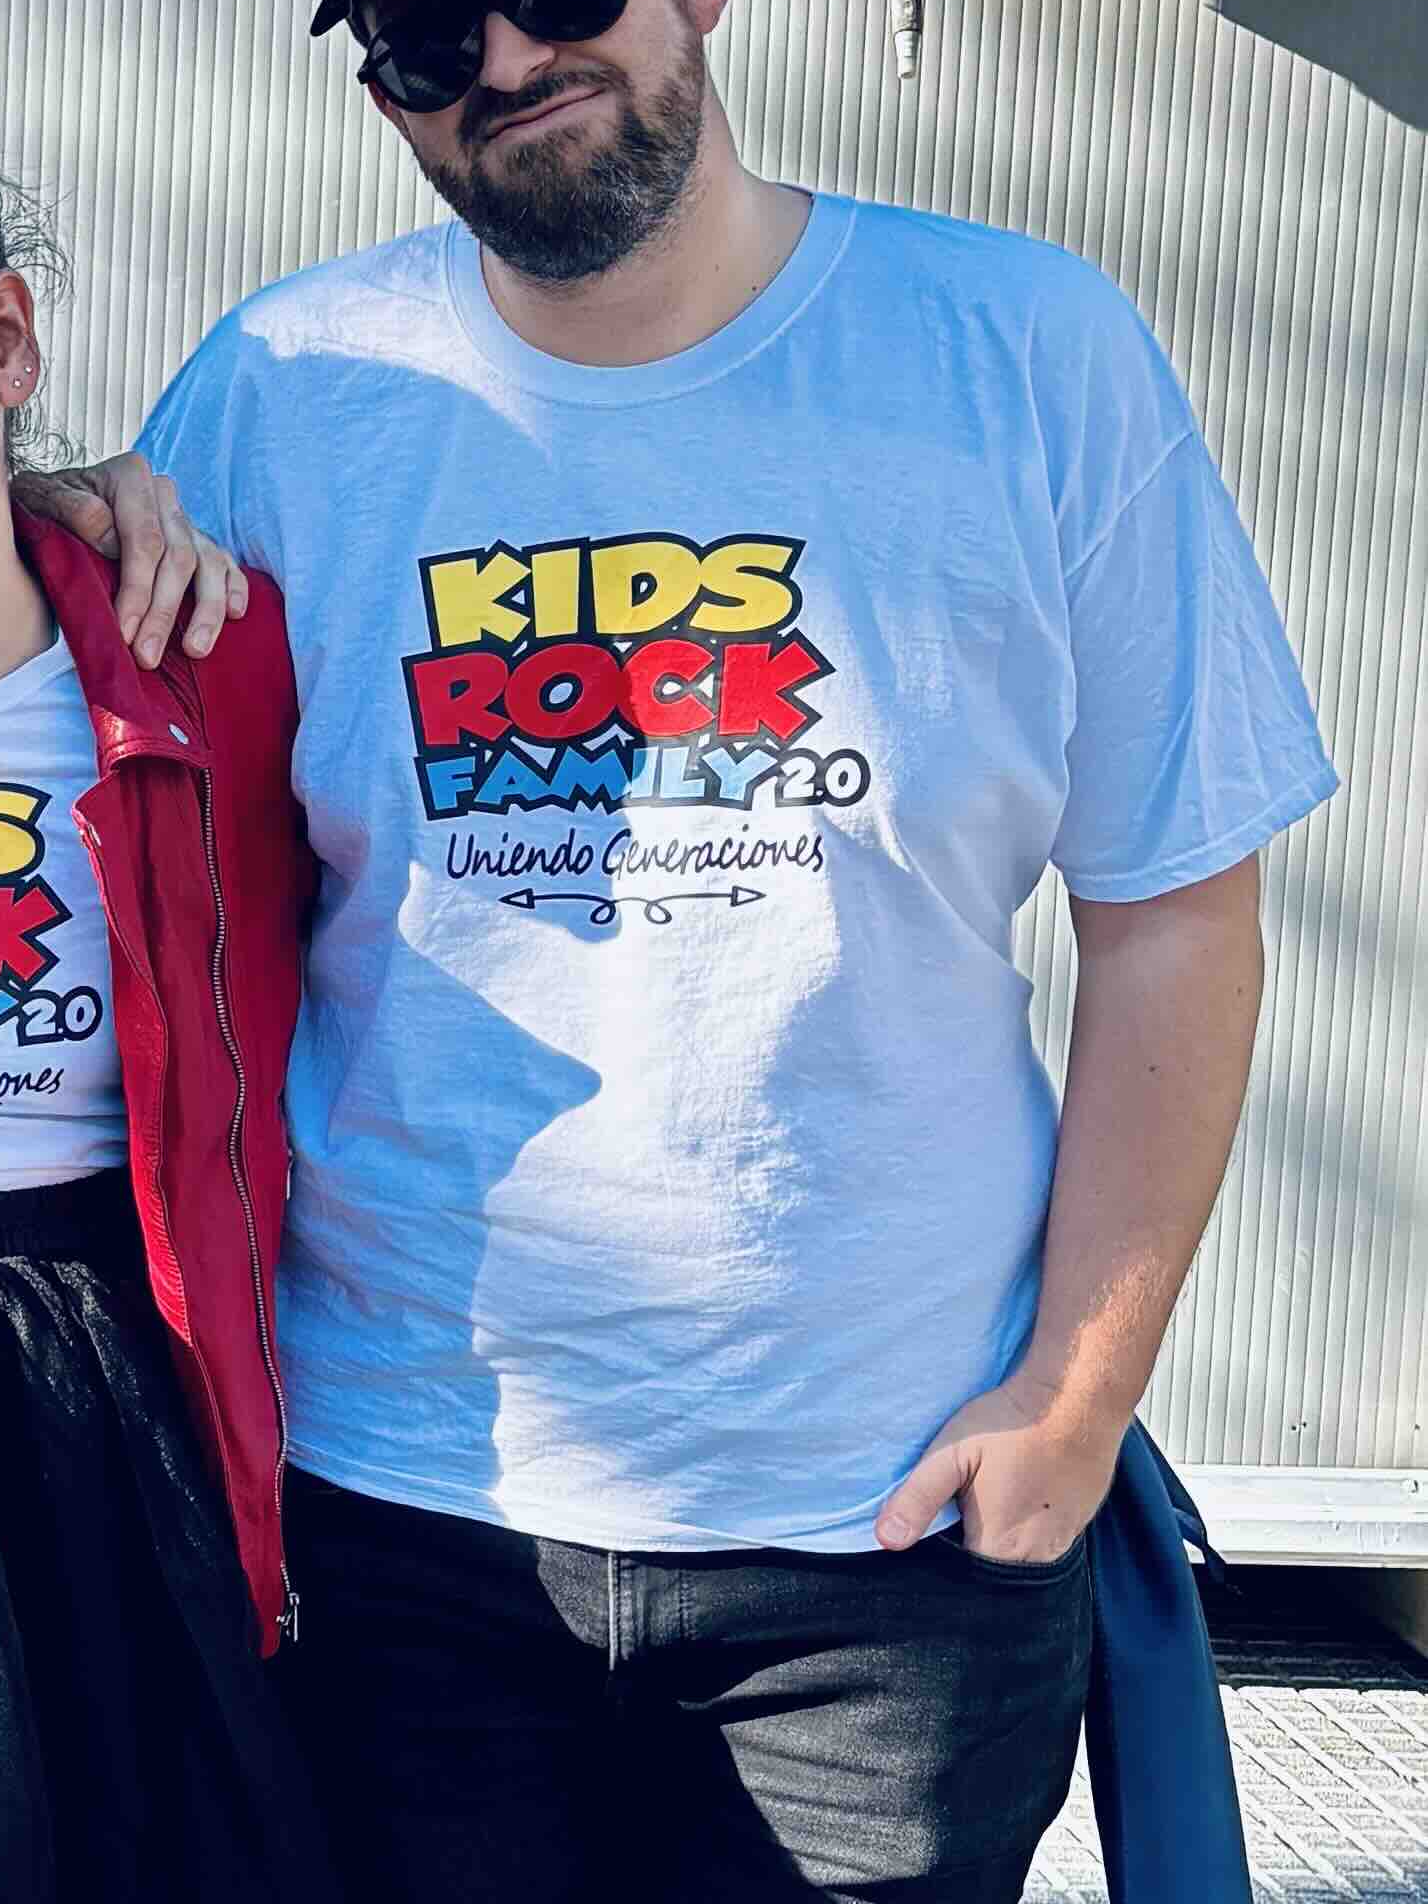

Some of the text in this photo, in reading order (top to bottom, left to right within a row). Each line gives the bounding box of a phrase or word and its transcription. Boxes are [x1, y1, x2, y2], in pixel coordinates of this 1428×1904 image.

[419, 532, 806, 649] KIDS
[402, 628, 836, 752] ROCK
[414, 741, 778, 821] FAMILY
[447, 824, 824, 880] Uniendo Generaciones
